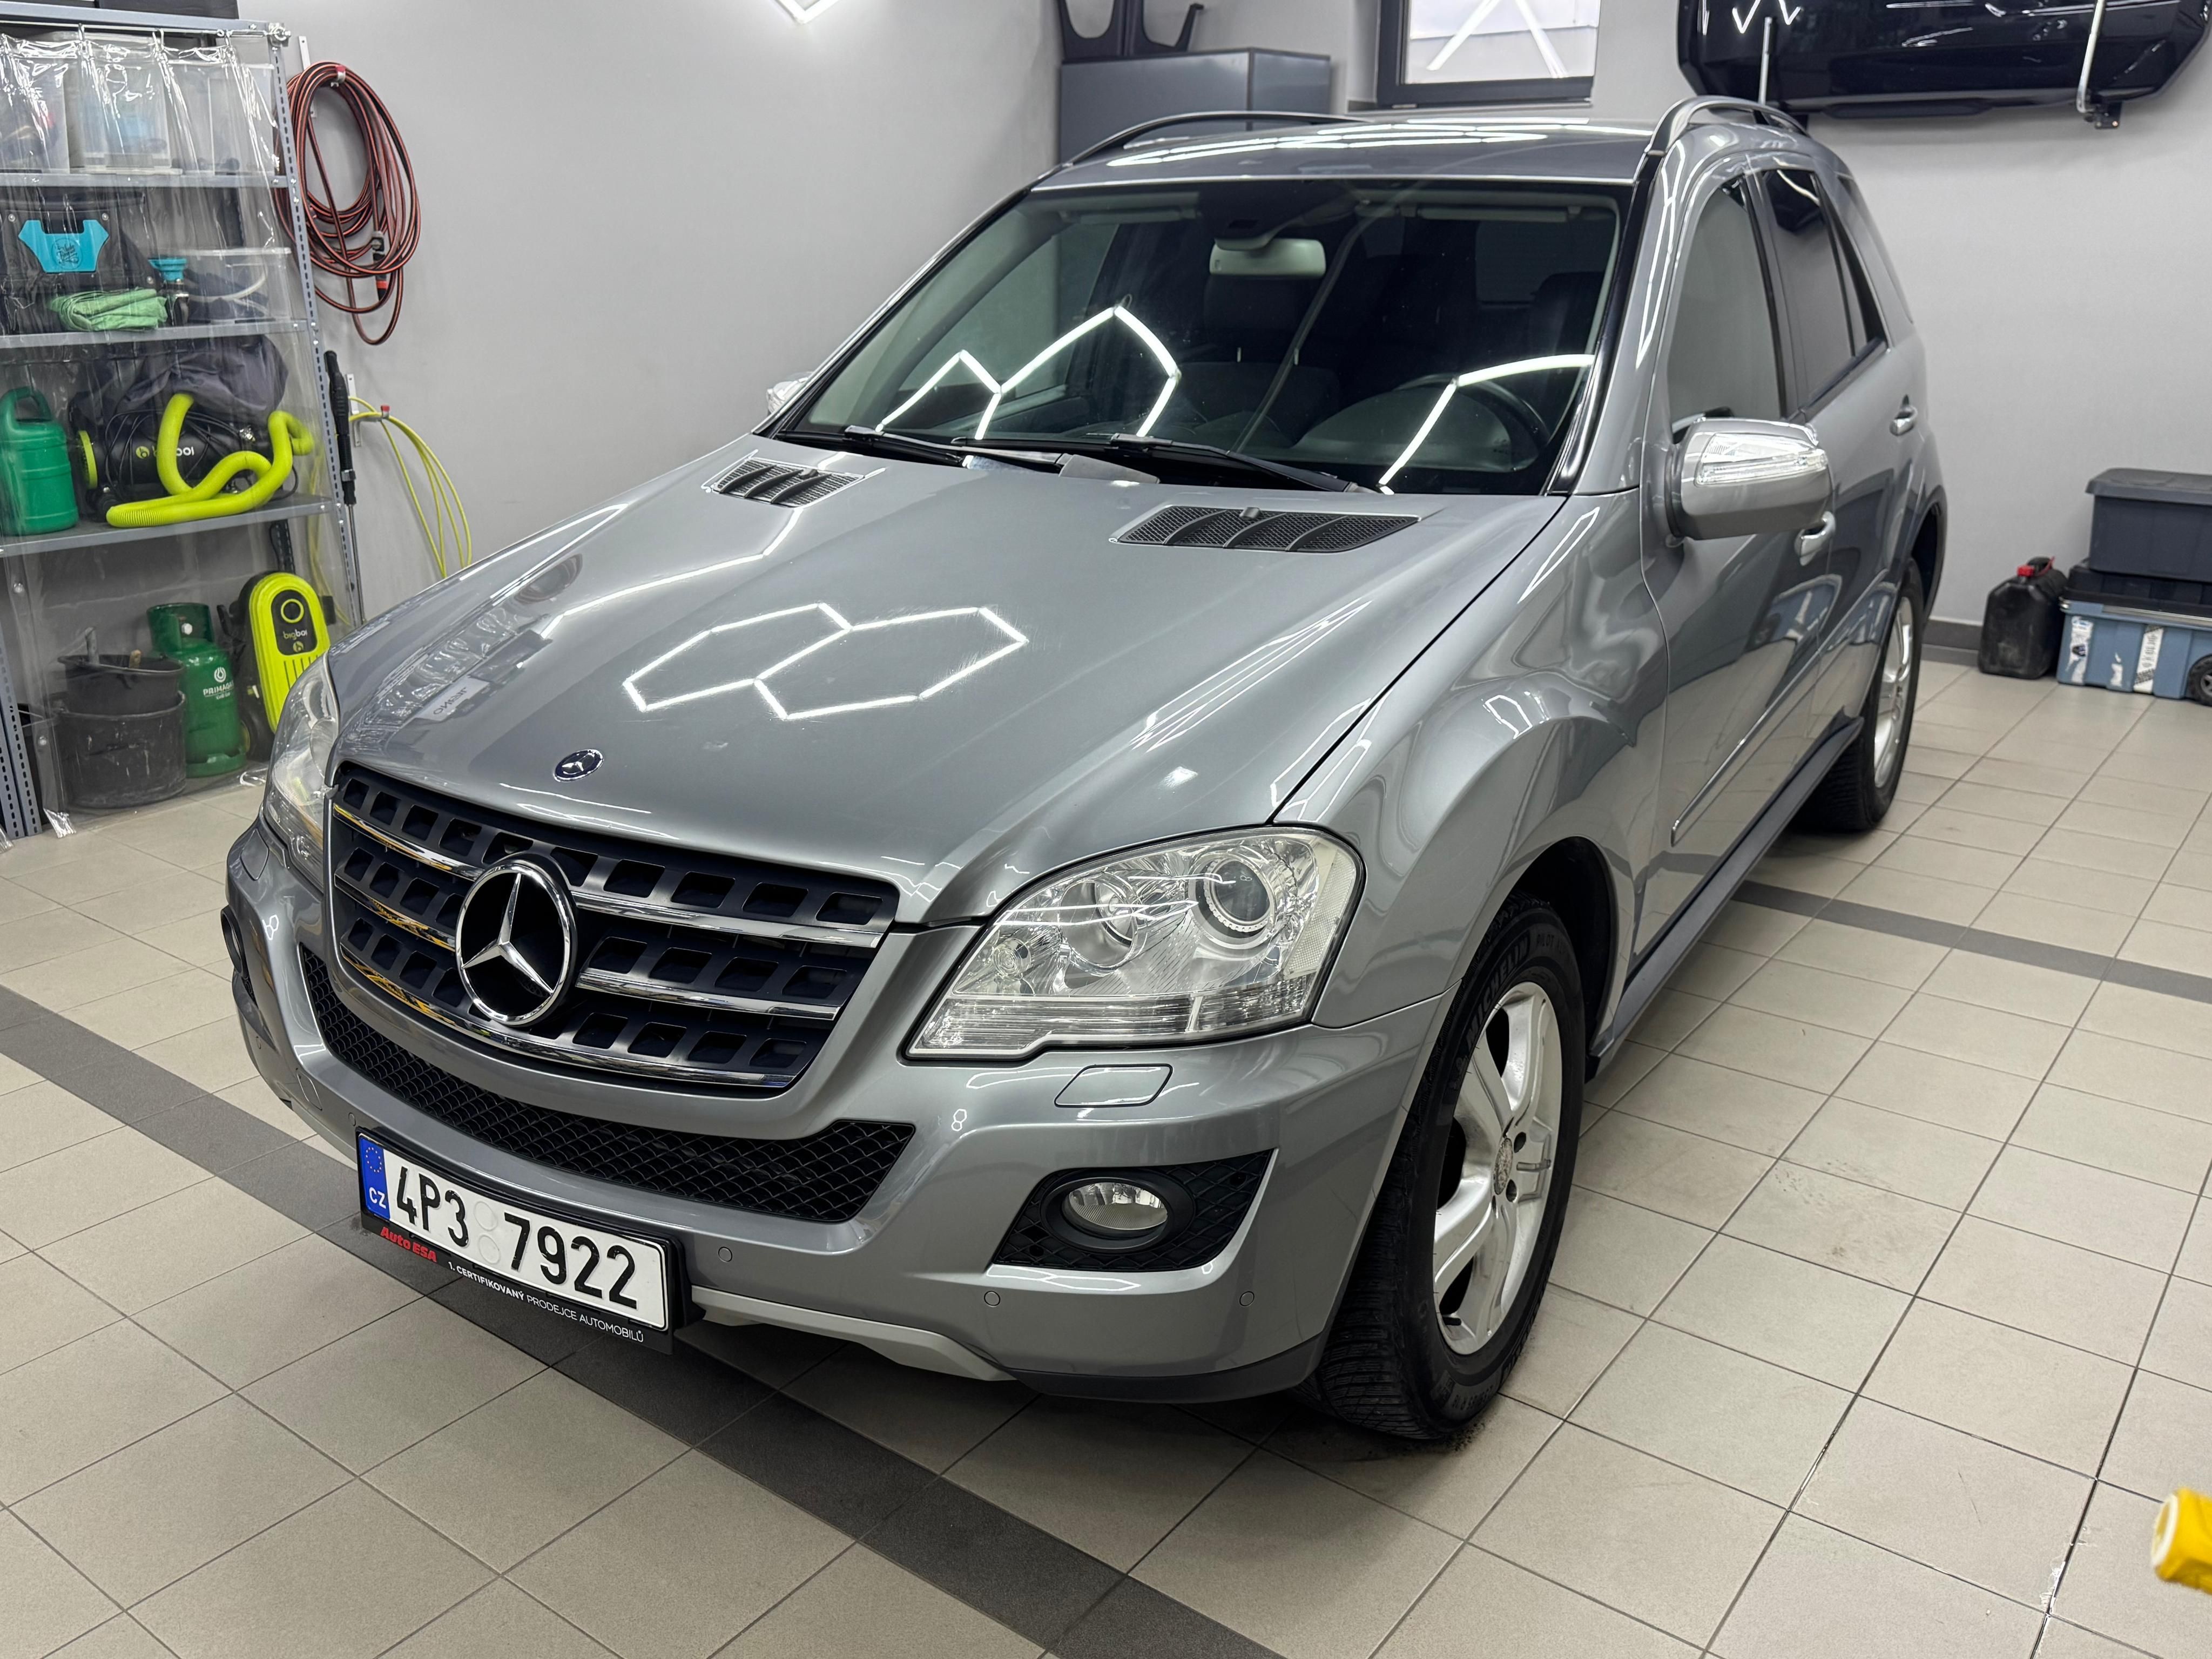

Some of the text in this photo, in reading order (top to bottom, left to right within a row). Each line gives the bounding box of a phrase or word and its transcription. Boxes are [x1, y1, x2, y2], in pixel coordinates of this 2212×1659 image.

[282, 629, 308, 640] bigboi
[1466, 936, 1529, 1051] MICHELIN
[369, 1187, 386, 1209] CZ
[380, 1226, 437, 1263] Auto ESA
[396, 1166, 637, 1310] 4P3 7922
[448, 1262, 644, 1343] 1. CERTIFIKOVANÝ PRODEJCE AUTOMOBILŮ
